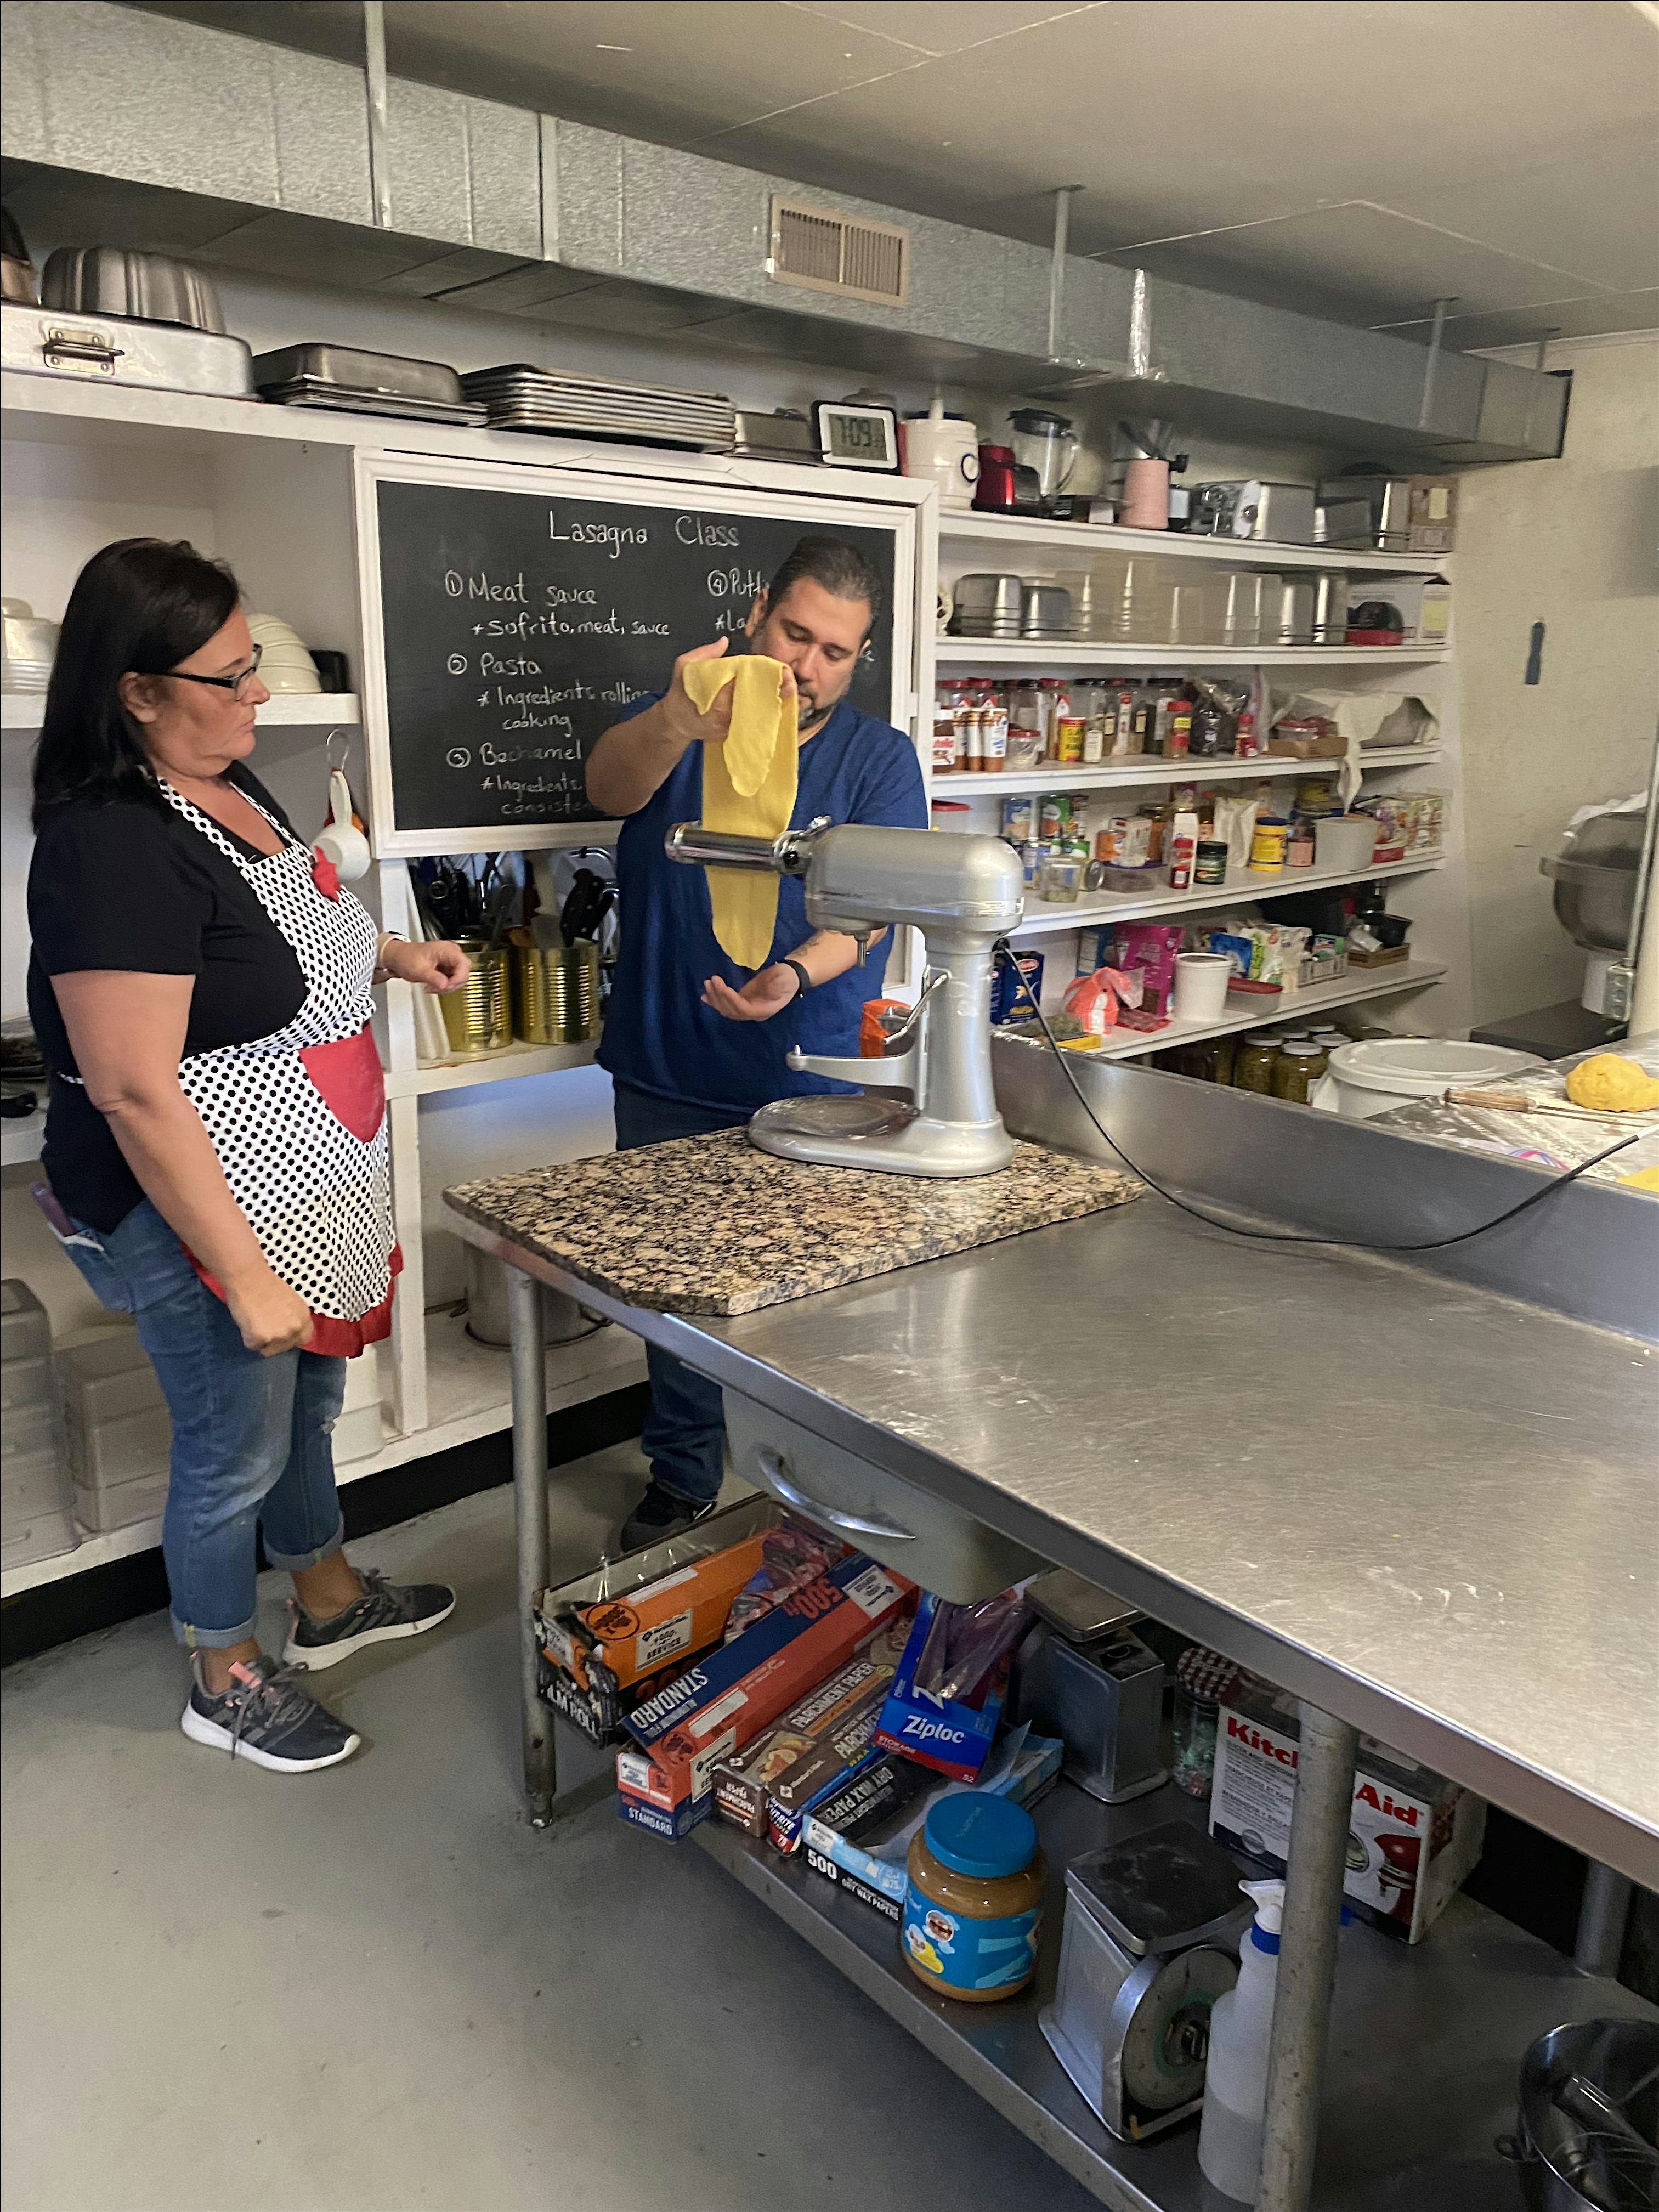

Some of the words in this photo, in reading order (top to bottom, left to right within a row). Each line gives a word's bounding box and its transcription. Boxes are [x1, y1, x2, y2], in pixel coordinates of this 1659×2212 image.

[550, 511, 648, 559] Lasagna
[675, 516, 740, 547] Class
[469, 572, 529, 603] Meat
[545, 585, 598, 606] sauce
[632, 620, 670, 636] sauce
[480, 652, 542, 676] Pasta
[601, 681, 649, 704] rollin
[502, 712, 573, 738] cooking
[630, 1668, 709, 1729] STANDARD
[790, 1683, 850, 1728] PARCHMENT
[841, 1662, 876, 1688] PAPER
[903, 1715, 965, 1744] Ziploc
[850, 1780, 877, 1803] WAX
[1355, 1783, 1418, 1828] Aid
[628, 1807, 673, 1836] STANDARD
[808, 1848, 837, 1880] 500
